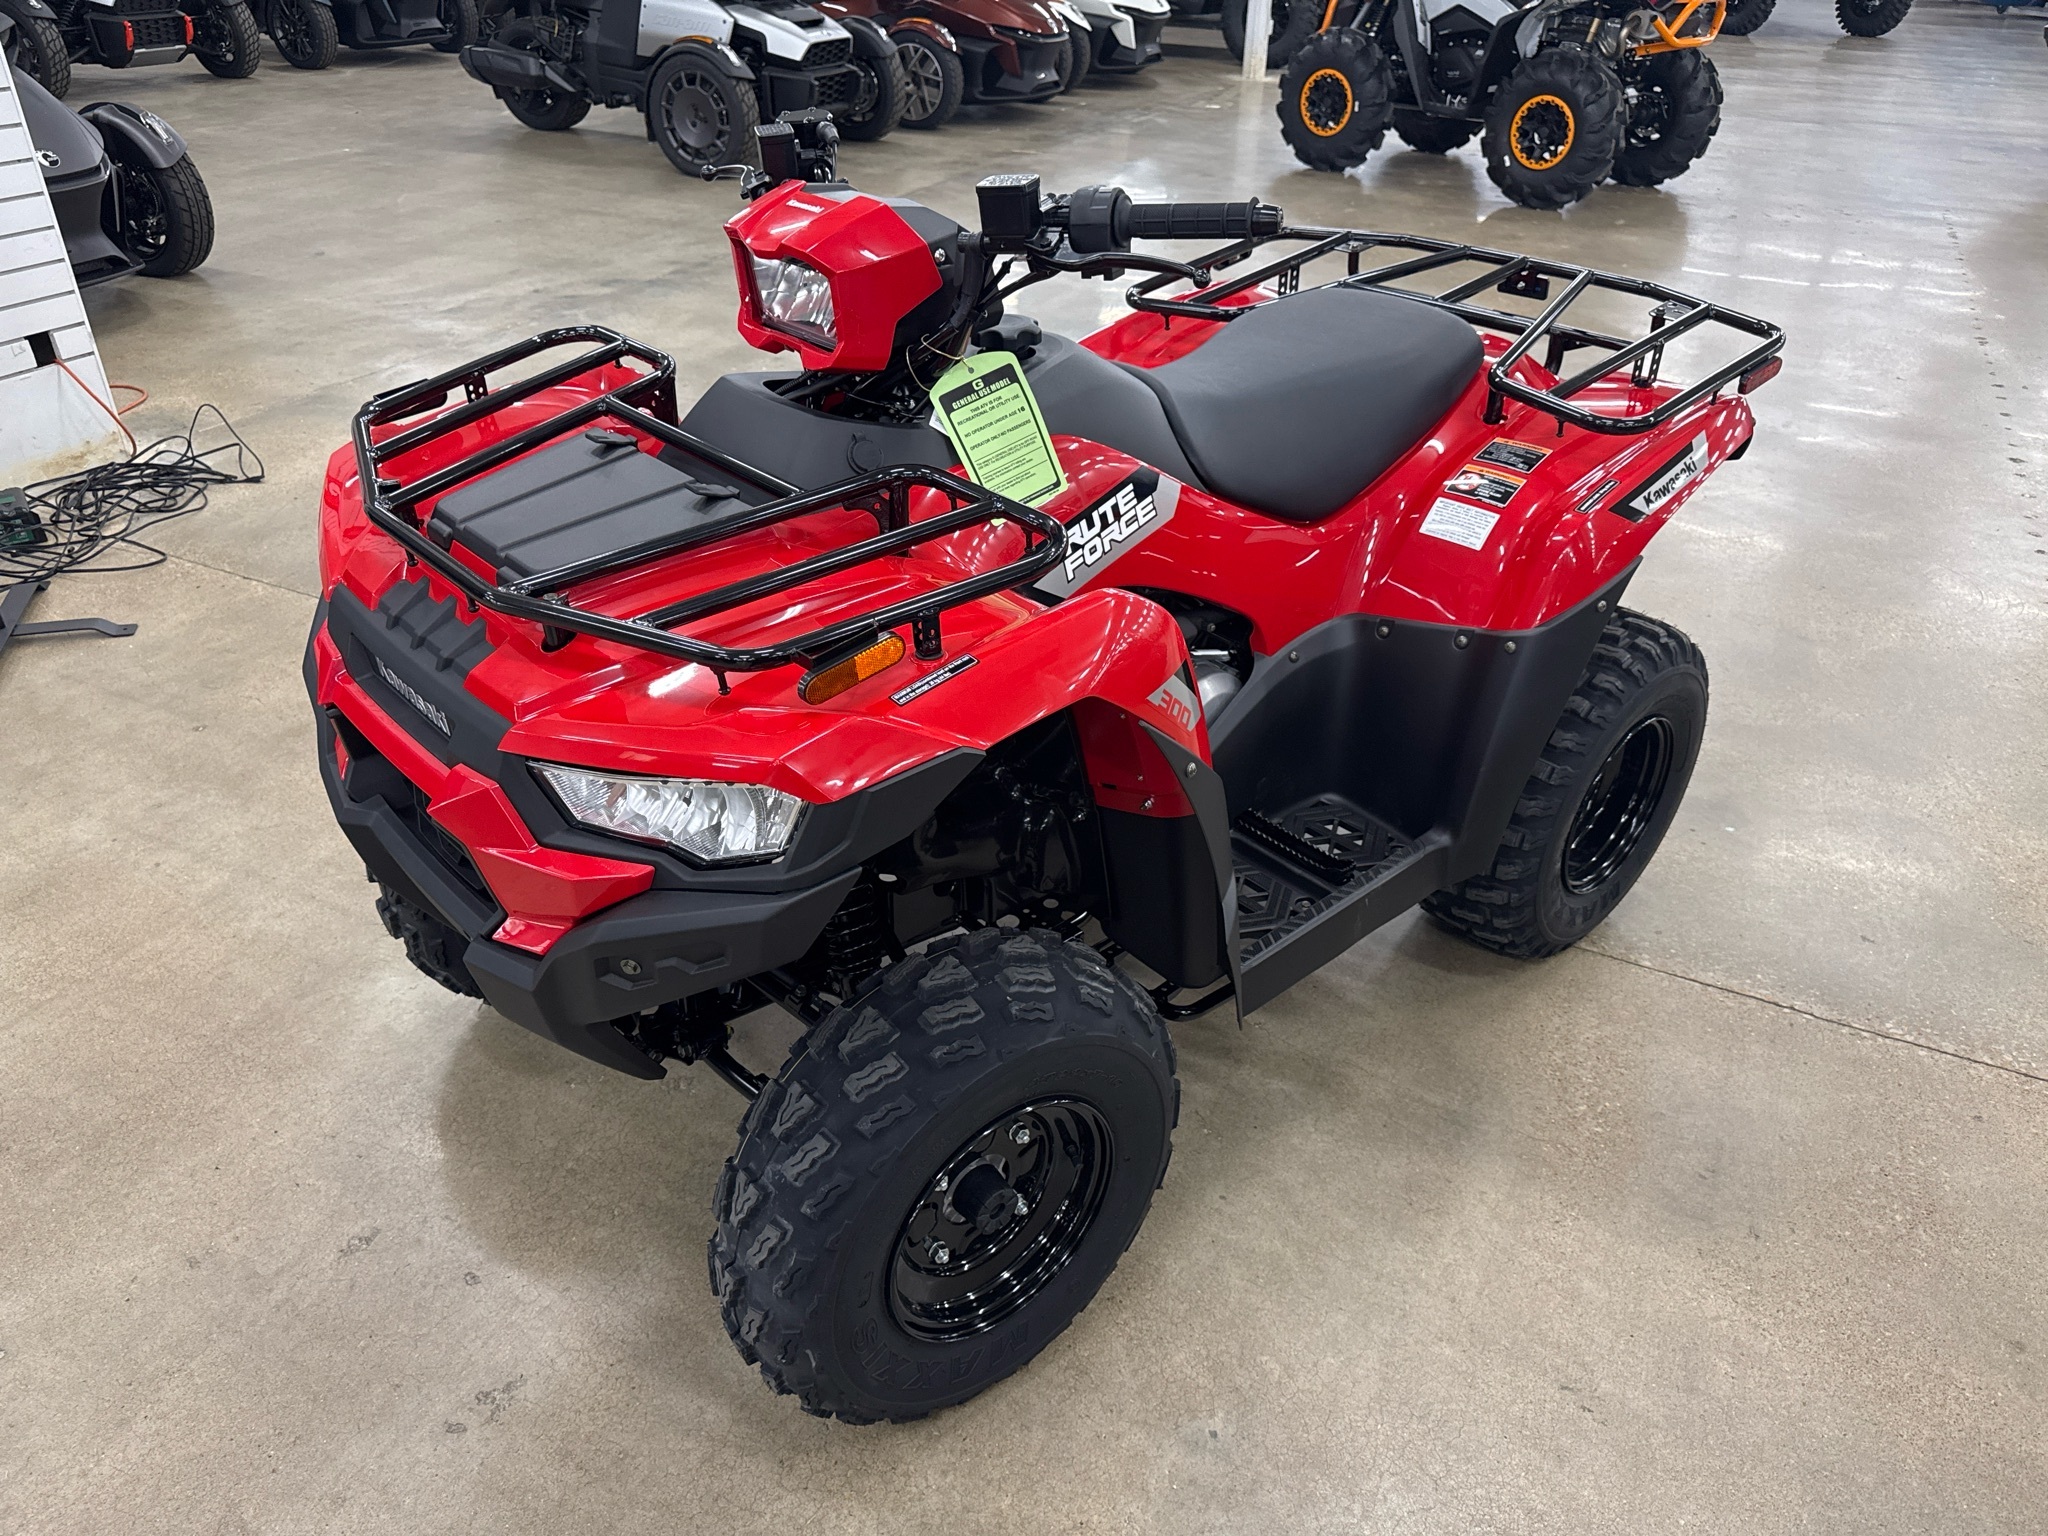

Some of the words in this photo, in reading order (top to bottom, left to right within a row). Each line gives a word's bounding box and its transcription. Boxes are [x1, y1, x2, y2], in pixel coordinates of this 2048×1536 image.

[952, 391, 980, 410] GENERAL
[978, 386, 991, 398] USE
[990, 377, 1011, 393] MODEL
[972, 378, 984, 391] G
[957, 409, 989, 426] RECREATIONAL
[996, 398, 1011, 408] UTILITY
[970, 406, 980, 414] THIS
[980, 402, 989, 410] ATV
[993, 395, 1003, 403] FOR
[971, 421, 994, 435] OPERATOR
[994, 414, 1009, 425] UNDER
[1017, 405, 1026, 413] 16
[970, 438, 991, 451] OPERATOR
[1007, 418, 1031, 433] PASSENGERS
[1643, 457, 1698, 509] Kawasaki
[1066, 483, 1138, 556] RUTE
[1064, 494, 1157, 582] FORCE
[375, 656, 452, 737] Kawasaki
[1159, 689, 1192, 728] 300
[851, 1318, 1030, 1390] MAXXIS
